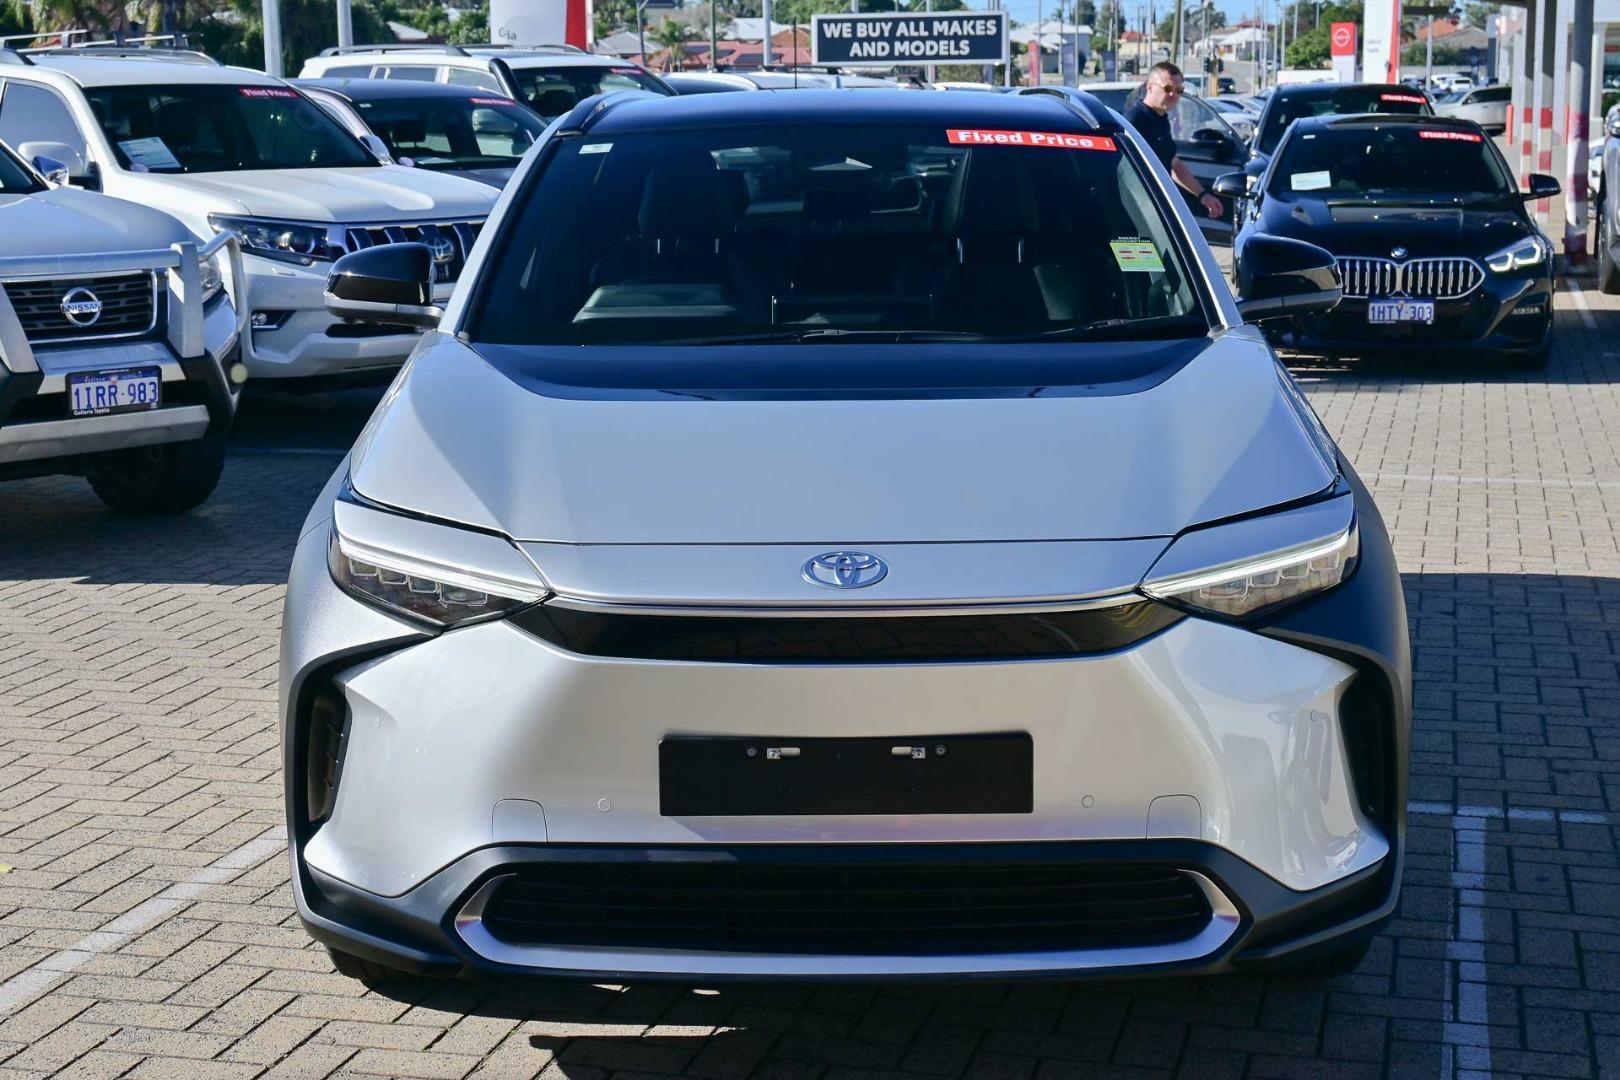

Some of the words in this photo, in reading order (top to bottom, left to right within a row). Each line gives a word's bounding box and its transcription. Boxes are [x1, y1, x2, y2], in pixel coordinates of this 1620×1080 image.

[823, 22, 852, 38] WE
[857, 22, 892, 37] BUY
[896, 21, 929, 37] ALL
[933, 20, 997, 36] MAKES
[849, 41, 890, 57] AND
[894, 40, 970, 56] MODELS
[957, 131, 1024, 145] Fixed
[1029, 133, 1095, 148] Price
[67, 303, 100, 312] NISSAN
